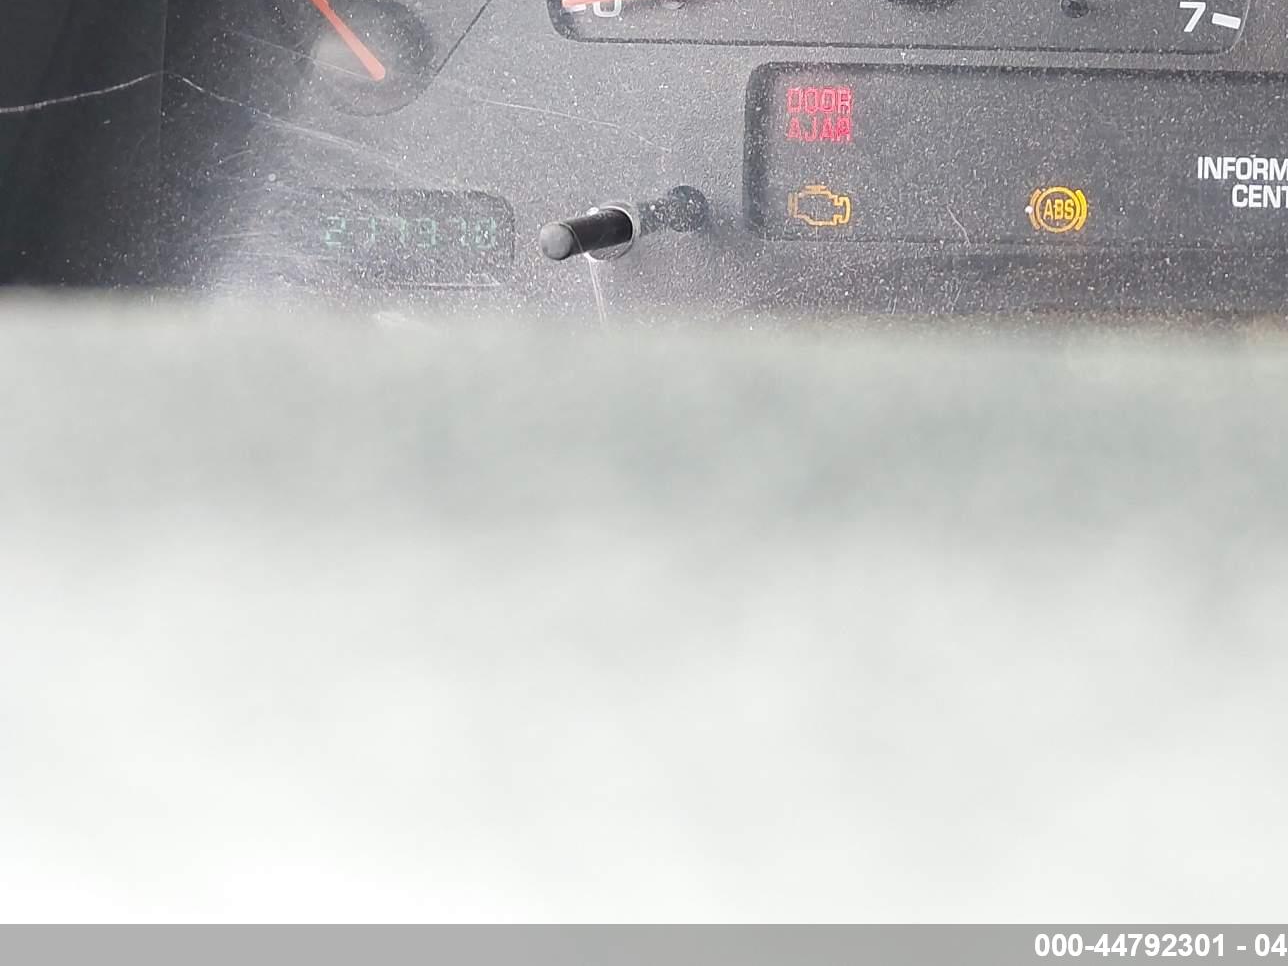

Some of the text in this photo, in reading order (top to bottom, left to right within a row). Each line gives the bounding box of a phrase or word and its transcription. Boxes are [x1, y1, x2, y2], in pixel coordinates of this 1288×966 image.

[1178, 2, 1208, 33] 7
[786, 87, 851, 113] DOOR
[787, 117, 851, 141] AJAR
[1043, 199, 1075, 221] ABS
